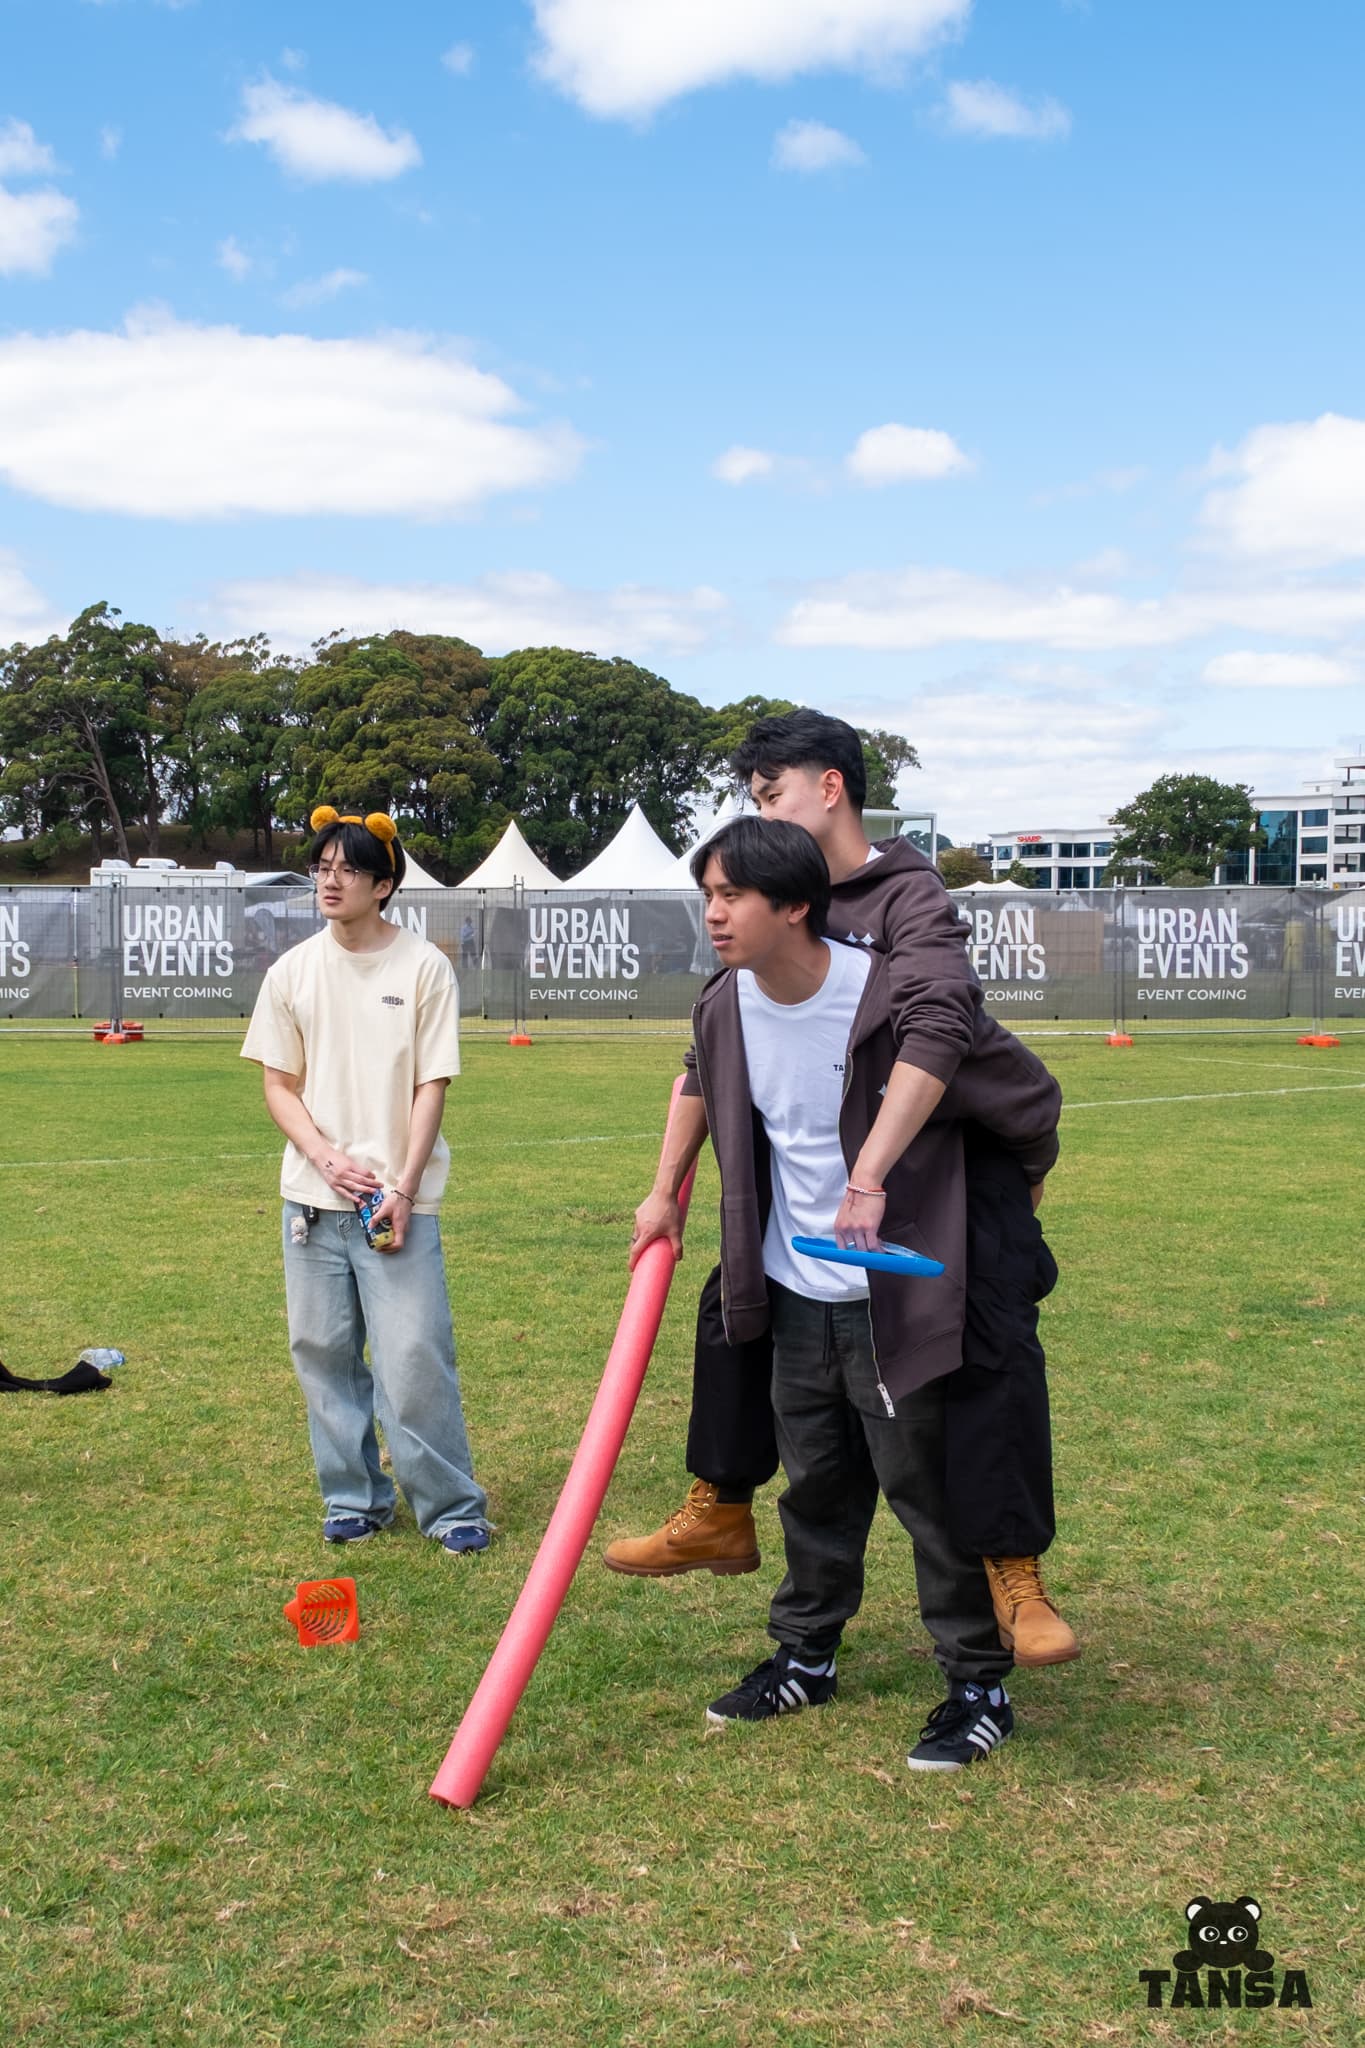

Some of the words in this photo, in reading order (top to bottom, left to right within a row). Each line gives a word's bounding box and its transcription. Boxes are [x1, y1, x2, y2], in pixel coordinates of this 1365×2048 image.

[123, 905, 223, 941] URBAN
[529, 908, 630, 943] URBAN
[1137, 908, 1238, 943] URBAN
[123, 940, 234, 977] EVENTS
[529, 943, 640, 979] EVENTS
[1138, 942, 1248, 979] EVENTS
[123, 986, 170, 998] EVENT
[173, 986, 233, 998] COMING
[529, 989, 576, 1000] EVENT
[579, 989, 639, 1000] COMING
[984, 989, 1044, 1001] COMING
[1137, 989, 1184, 1001] EVENT
[1187, 989, 1247, 1001] COMING
